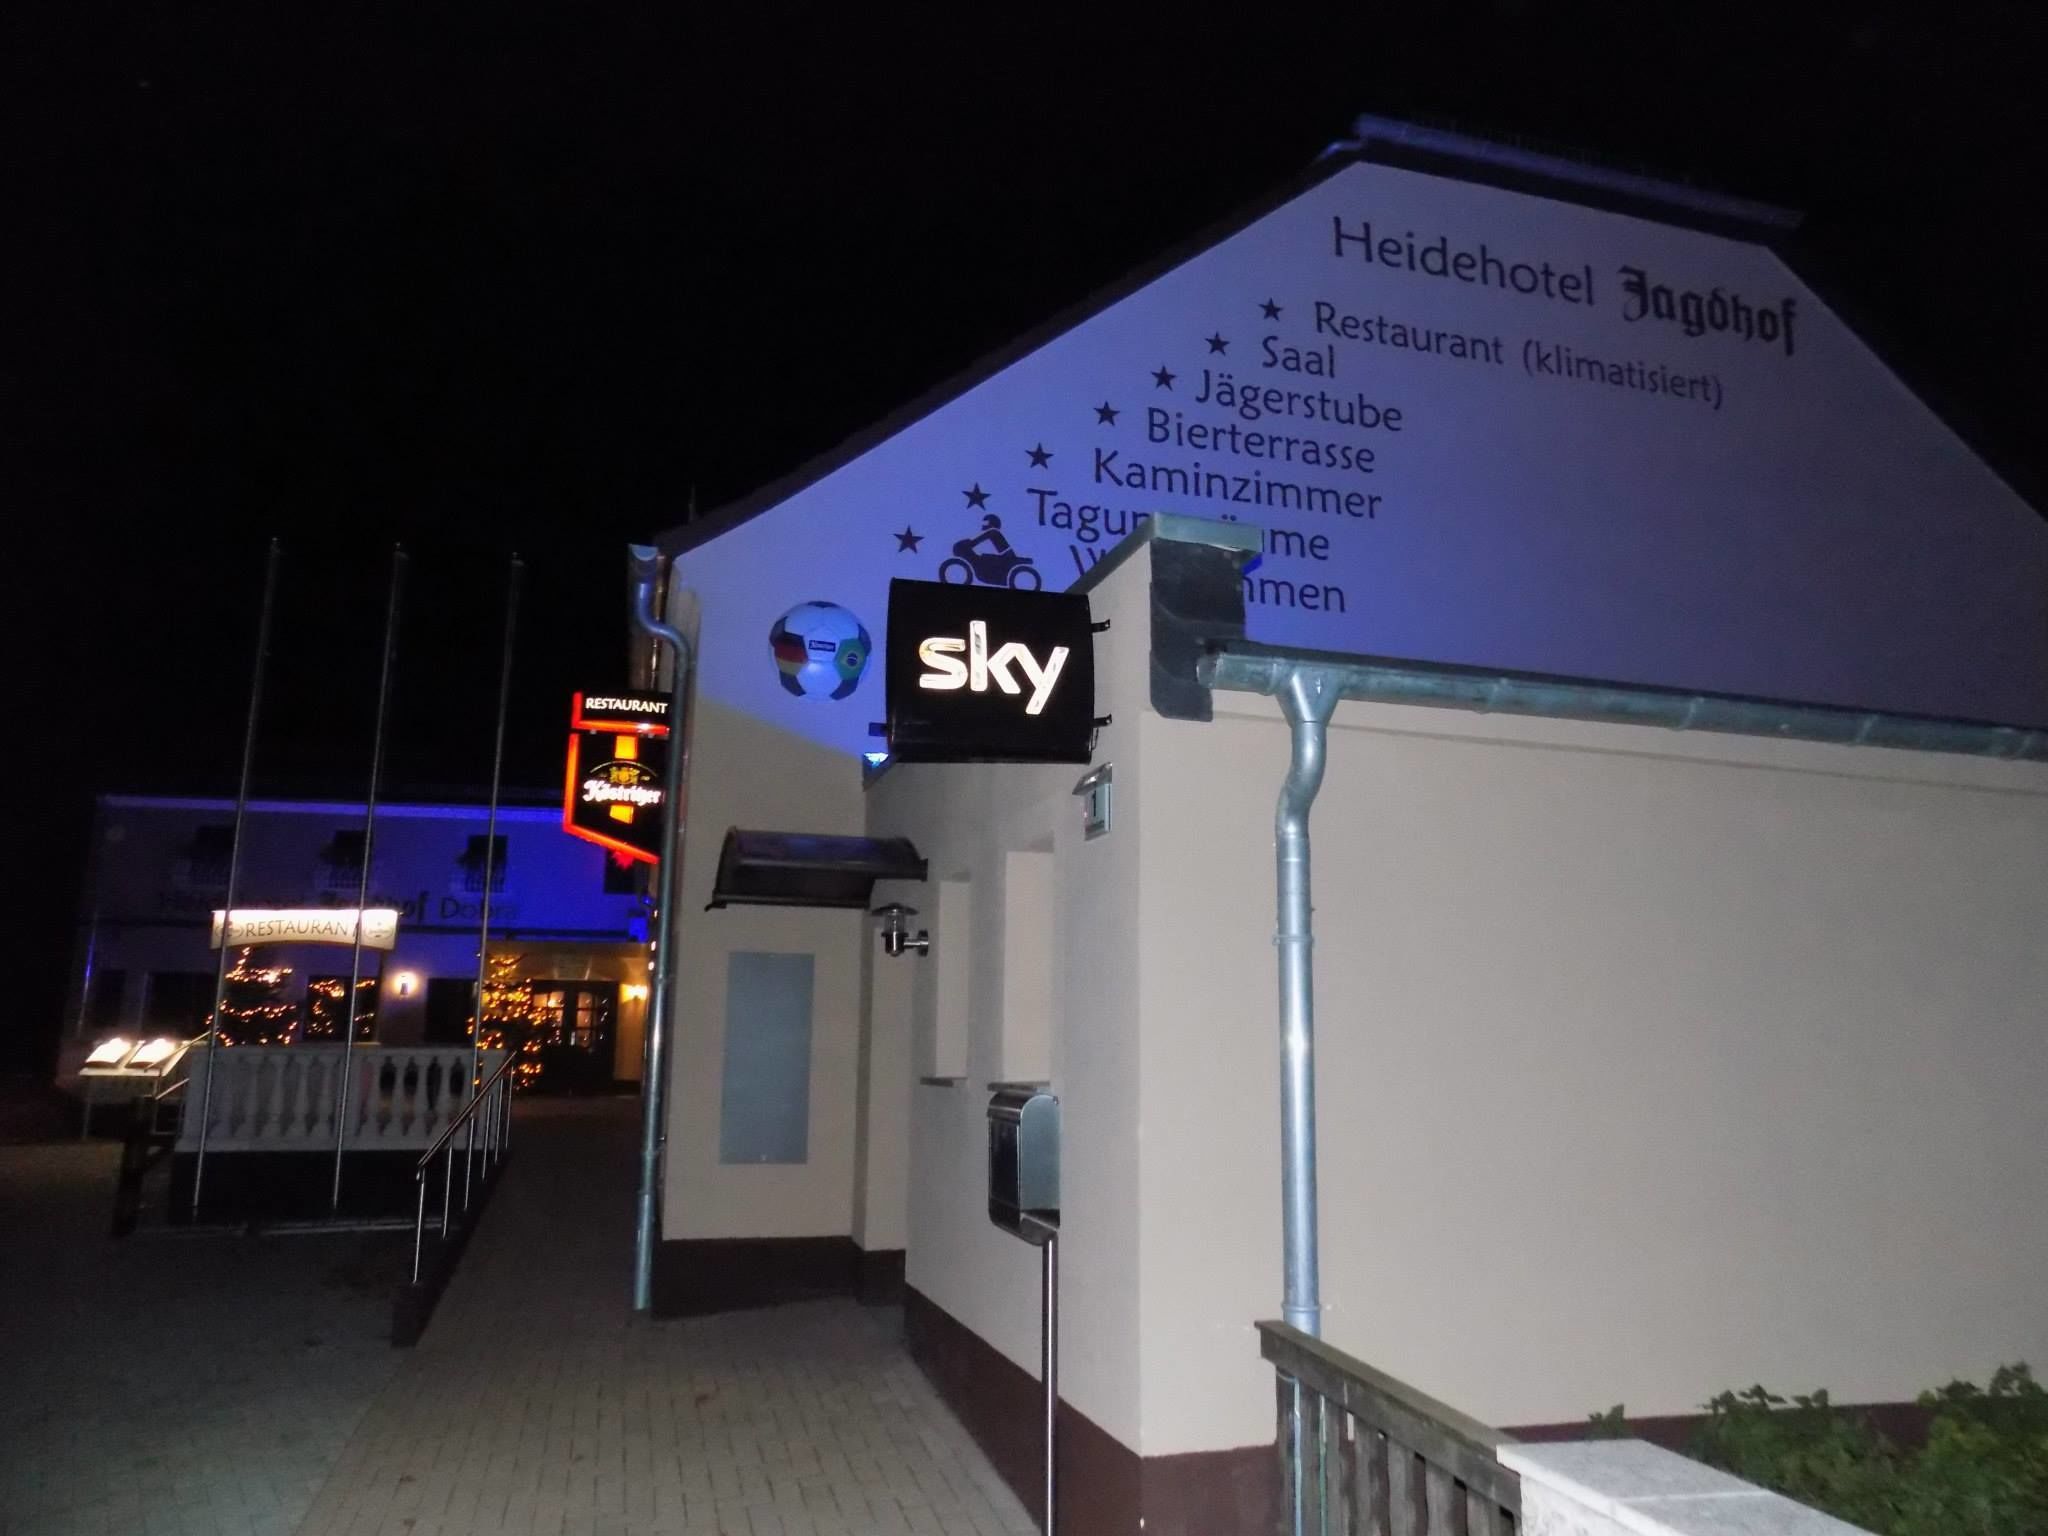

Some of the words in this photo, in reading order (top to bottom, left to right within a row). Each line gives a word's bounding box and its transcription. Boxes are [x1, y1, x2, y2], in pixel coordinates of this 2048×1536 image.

[1332, 216, 1595, 306] Heidehotel
[1618, 265, 1798, 356] Jagdhof
[1262, 335, 1335, 379] Saal
[1315, 301, 1504, 366] Restaurant
[1522, 339, 1724, 411] (klimatisiert)
[1195, 370, 1404, 432] Jägerstube
[1148, 408, 1376, 474] Bierterrasse
[1094, 447, 1383, 520] Kaminzimmer
[918, 619, 1070, 716] sky
[585, 697, 668, 715] RESTAURANT
